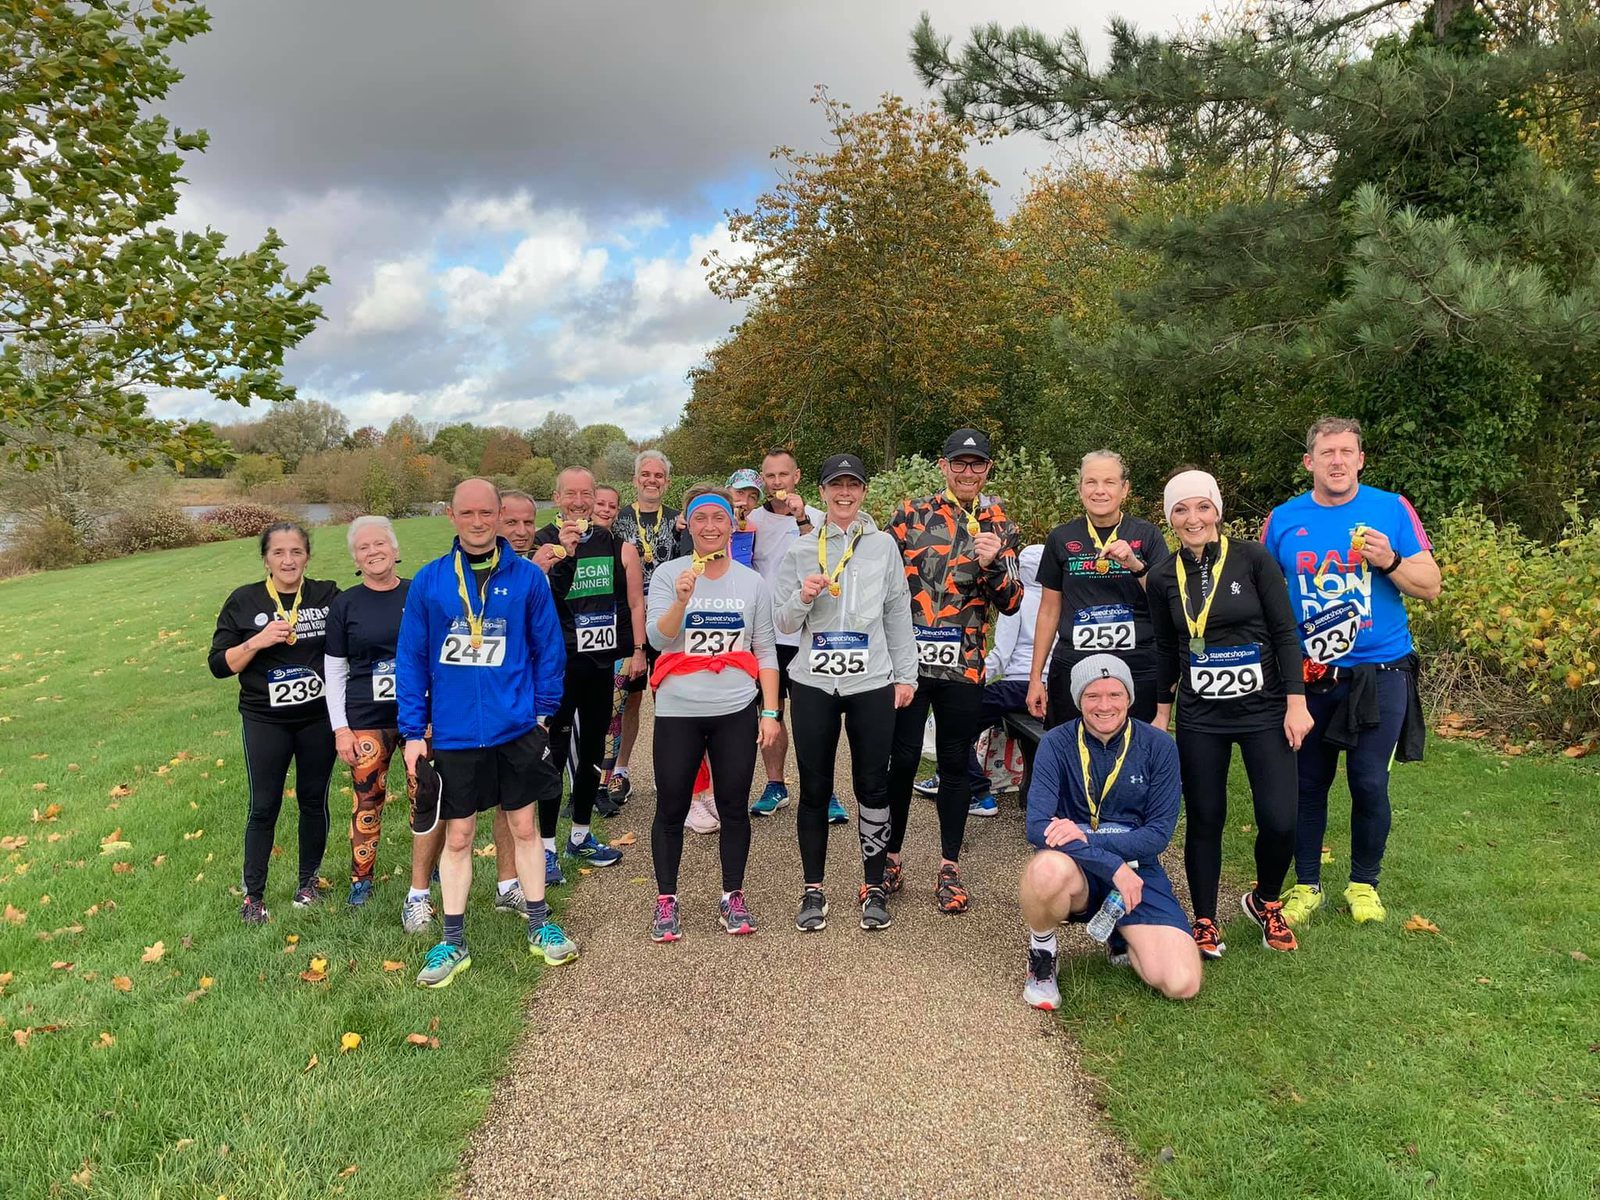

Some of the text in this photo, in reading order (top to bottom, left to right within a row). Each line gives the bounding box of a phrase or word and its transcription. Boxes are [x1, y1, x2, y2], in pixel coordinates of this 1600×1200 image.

[576, 564, 610, 578] EGAN
[1298, 572, 1372, 599] LON
[581, 628, 614, 650] 240
[690, 631, 741, 653] 237
[1078, 624, 1131, 648] 252
[445, 637, 501, 663] 247
[812, 652, 865, 675] 235
[275, 678, 323, 703] 239
[1197, 668, 1258, 696] 229
